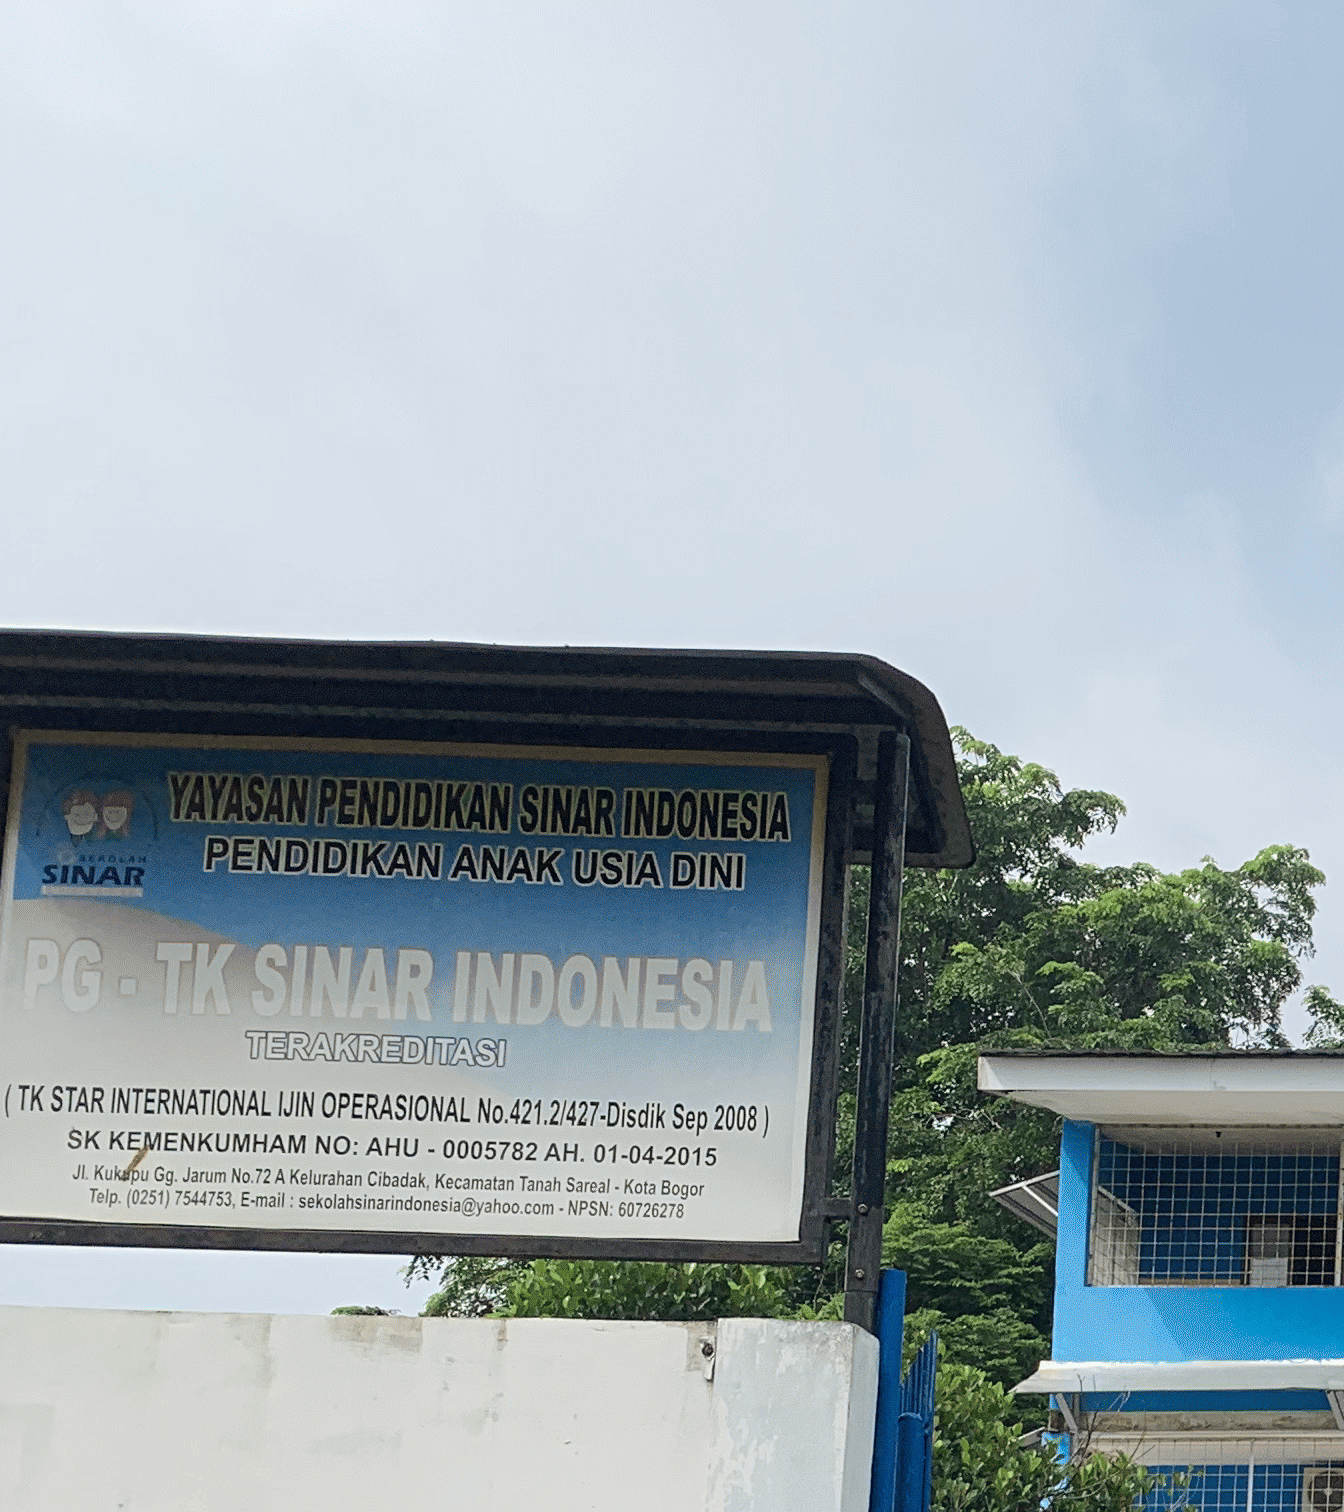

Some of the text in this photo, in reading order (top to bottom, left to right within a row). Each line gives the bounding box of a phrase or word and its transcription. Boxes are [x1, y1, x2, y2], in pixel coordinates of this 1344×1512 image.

[168, 771, 792, 842] YAYASAN PENDIDIKAN SINAR INDONESIA
[41, 865, 145, 886] SINAR
[203, 836, 747, 890] PENDIDIKAN ANAK USIA DINI
[24, 938, 103, 1014] PG
[155, 941, 236, 1016] TK
[250, 943, 434, 1022] SINAR
[452, 950, 773, 1032] INDONESIA
[245, 1030, 507, 1068] TERAKREDITASI
[17, 1084, 46, 1112] TK
[50, 1085, 105, 1114] STAR
[110, 1087, 272, 1117] INTERNATIONAL
[277, 1090, 315, 1118] IJIN
[321, 1091, 471, 1123] OPERASIONAL
[671, 1102, 709, 1137] Sep
[713, 1104, 758, 1132] 2008
[66, 1127, 102, 1151] SK
[107, 1130, 307, 1155] KEMENKUMHAM
[314, 1134, 359, 1156] NO:
[364, 1136, 419, 1158] AHU
[442, 1138, 539, 1162] 0005782
[543, 1142, 585, 1163] AH.
[593, 1143, 718, 1167] 01-04-2015
[72, 1163, 89, 1181] Jl.
[153, 1165, 178, 1187] Gg.
[182, 1166, 227, 1184] Jarum
[230, 1167, 272, 1185] No.72
[274, 1168, 286, 1185] A
[289, 1168, 363, 1187] Kelurahan
[367, 1170, 430, 1192] Cibadak,
[434, 1172, 515, 1192] Kecamatan
[519, 1175, 562, 1193] Tanah
[565, 1176, 611, 1194] Sareal
[623, 1178, 657, 1196] Kota
[660, 1179, 705, 1201] Bogor
[89, 1187, 122, 1208] Telp.
[126, 1188, 170, 1210] (0251)
[174, 1189, 236, 1210] 7544753,
[240, 1191, 286, 1208] E-mail
[298, 1192, 555, 1218] sekolahsinarindonesia@yahoo.com
[567, 1199, 614, 1217] NPSN:
[618, 1201, 685, 1219] 60726278
